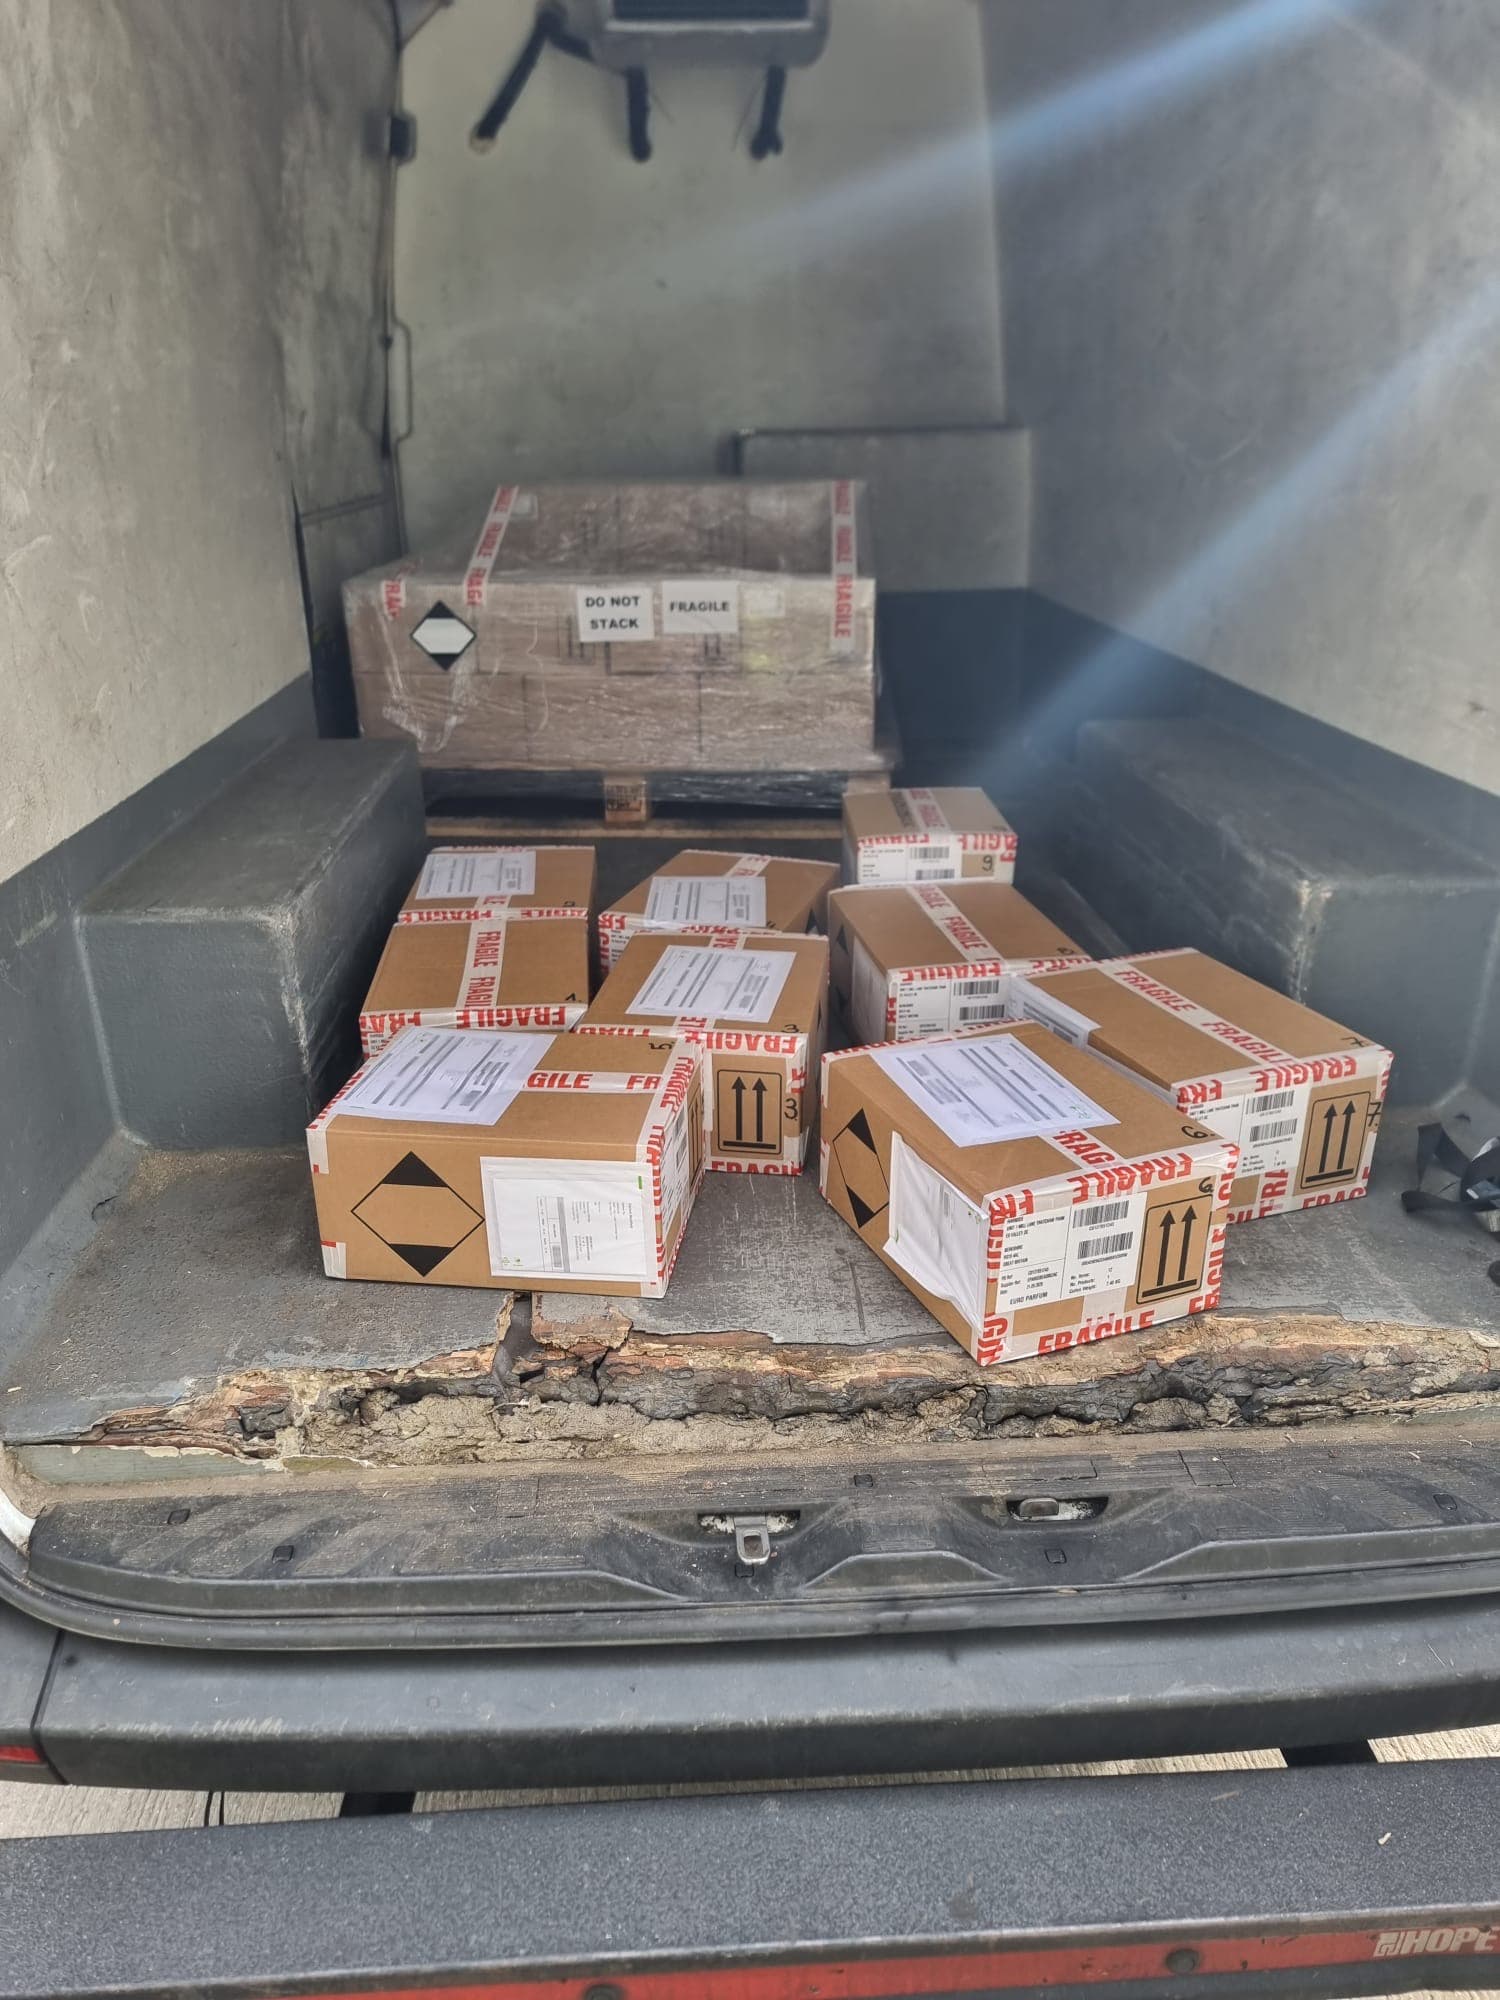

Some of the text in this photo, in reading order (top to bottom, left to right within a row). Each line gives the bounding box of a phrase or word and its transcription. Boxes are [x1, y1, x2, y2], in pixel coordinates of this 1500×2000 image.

[585, 595, 640, 608] DO NOT
[669, 601, 730, 613] FRAGILE
[590, 618, 639, 630] STACK
[473, 930, 501, 968] FRAGILE
[1114, 970, 1198, 1012] FRAGILE
[455, 1006, 566, 1031] FRAGILE
[1251, 1055, 1357, 1093] FRAGILE
[1067, 1152, 1193, 1205] FRAGILE
